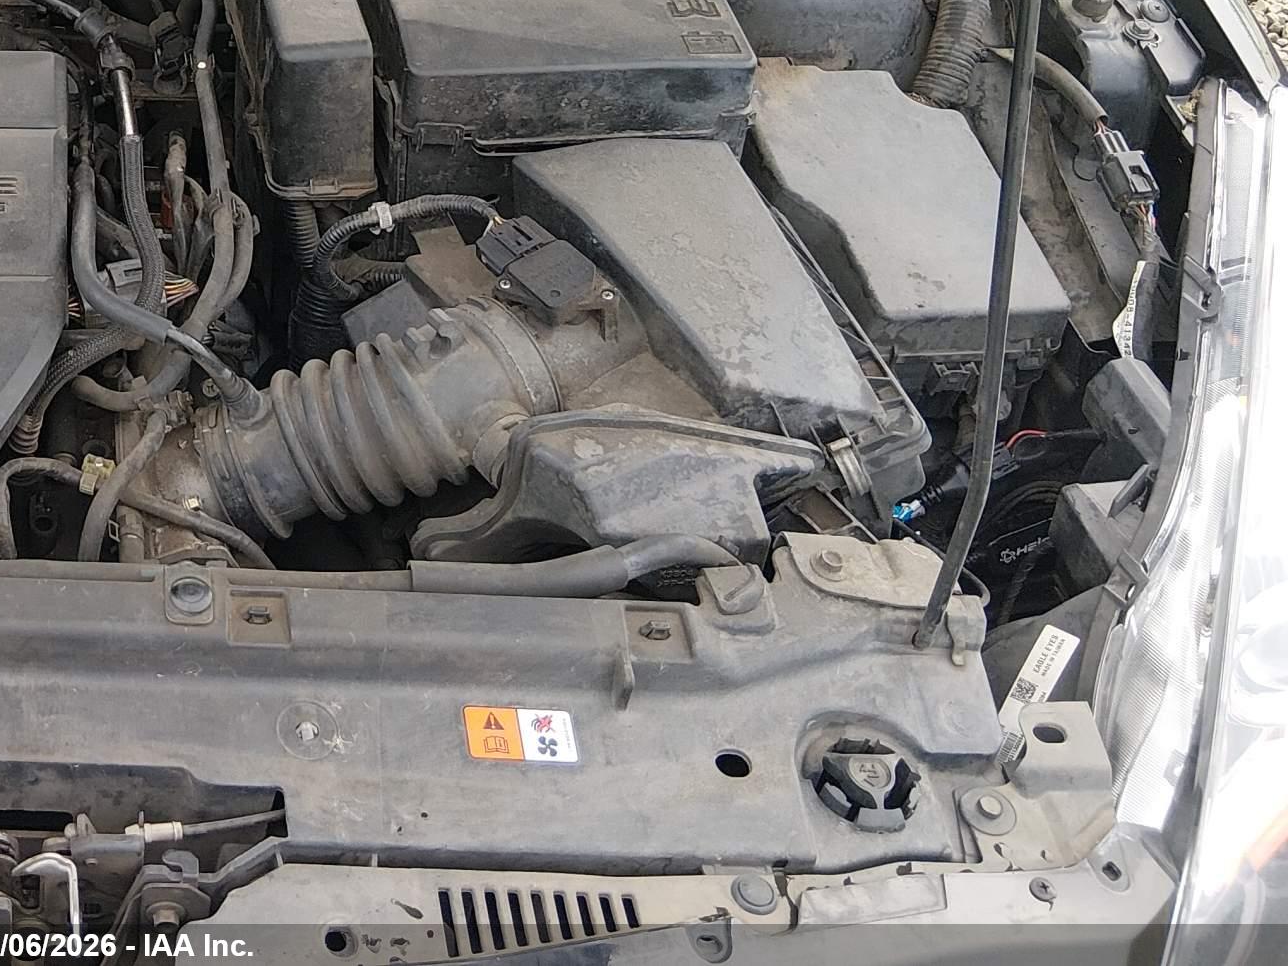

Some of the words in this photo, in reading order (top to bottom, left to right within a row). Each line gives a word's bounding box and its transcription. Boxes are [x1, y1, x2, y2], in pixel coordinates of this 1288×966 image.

[1033, 652, 1049, 674] EAGLE
[1044, 634, 1059, 655] EYES
[1040, 662, 1052, 677] MADE
